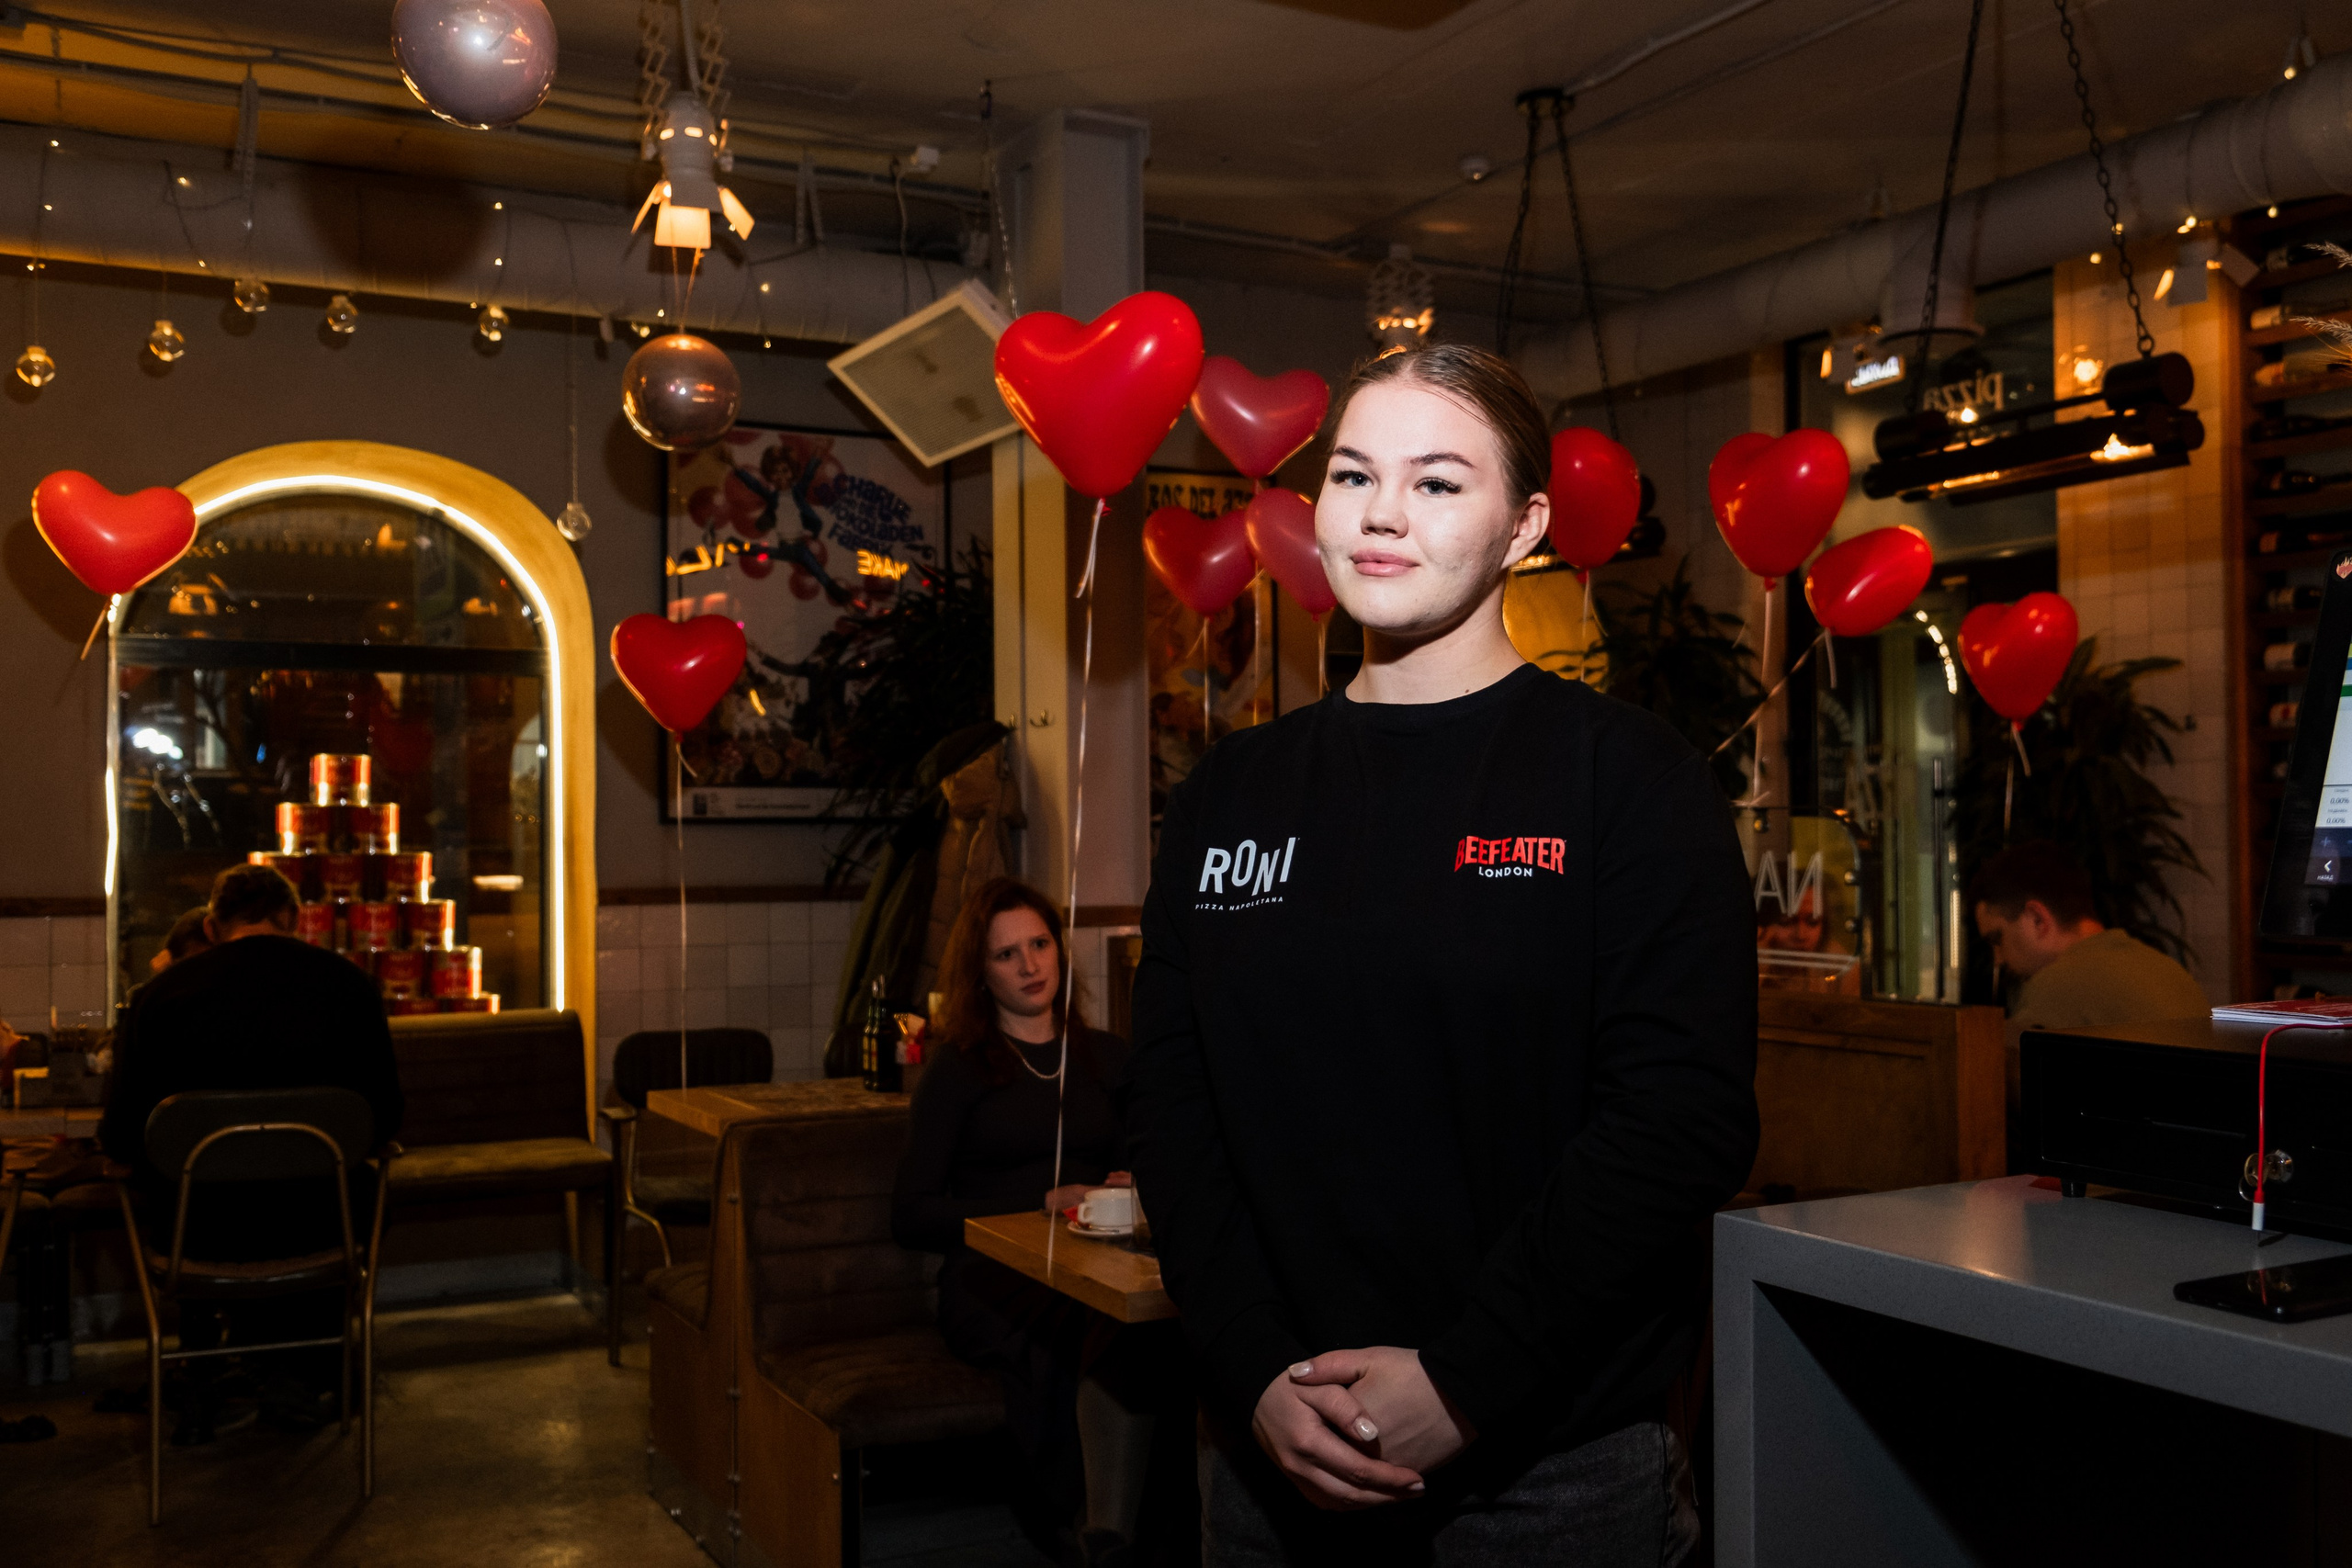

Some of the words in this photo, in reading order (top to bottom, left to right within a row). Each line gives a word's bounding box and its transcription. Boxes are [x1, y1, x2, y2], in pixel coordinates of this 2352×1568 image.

[1198, 836, 1296, 897] RONI
[1453, 835, 1566, 874] BEEFEATER
[1478, 866, 1534, 878] LONDON
[1229, 897, 1283, 911] NAPOLETANA
